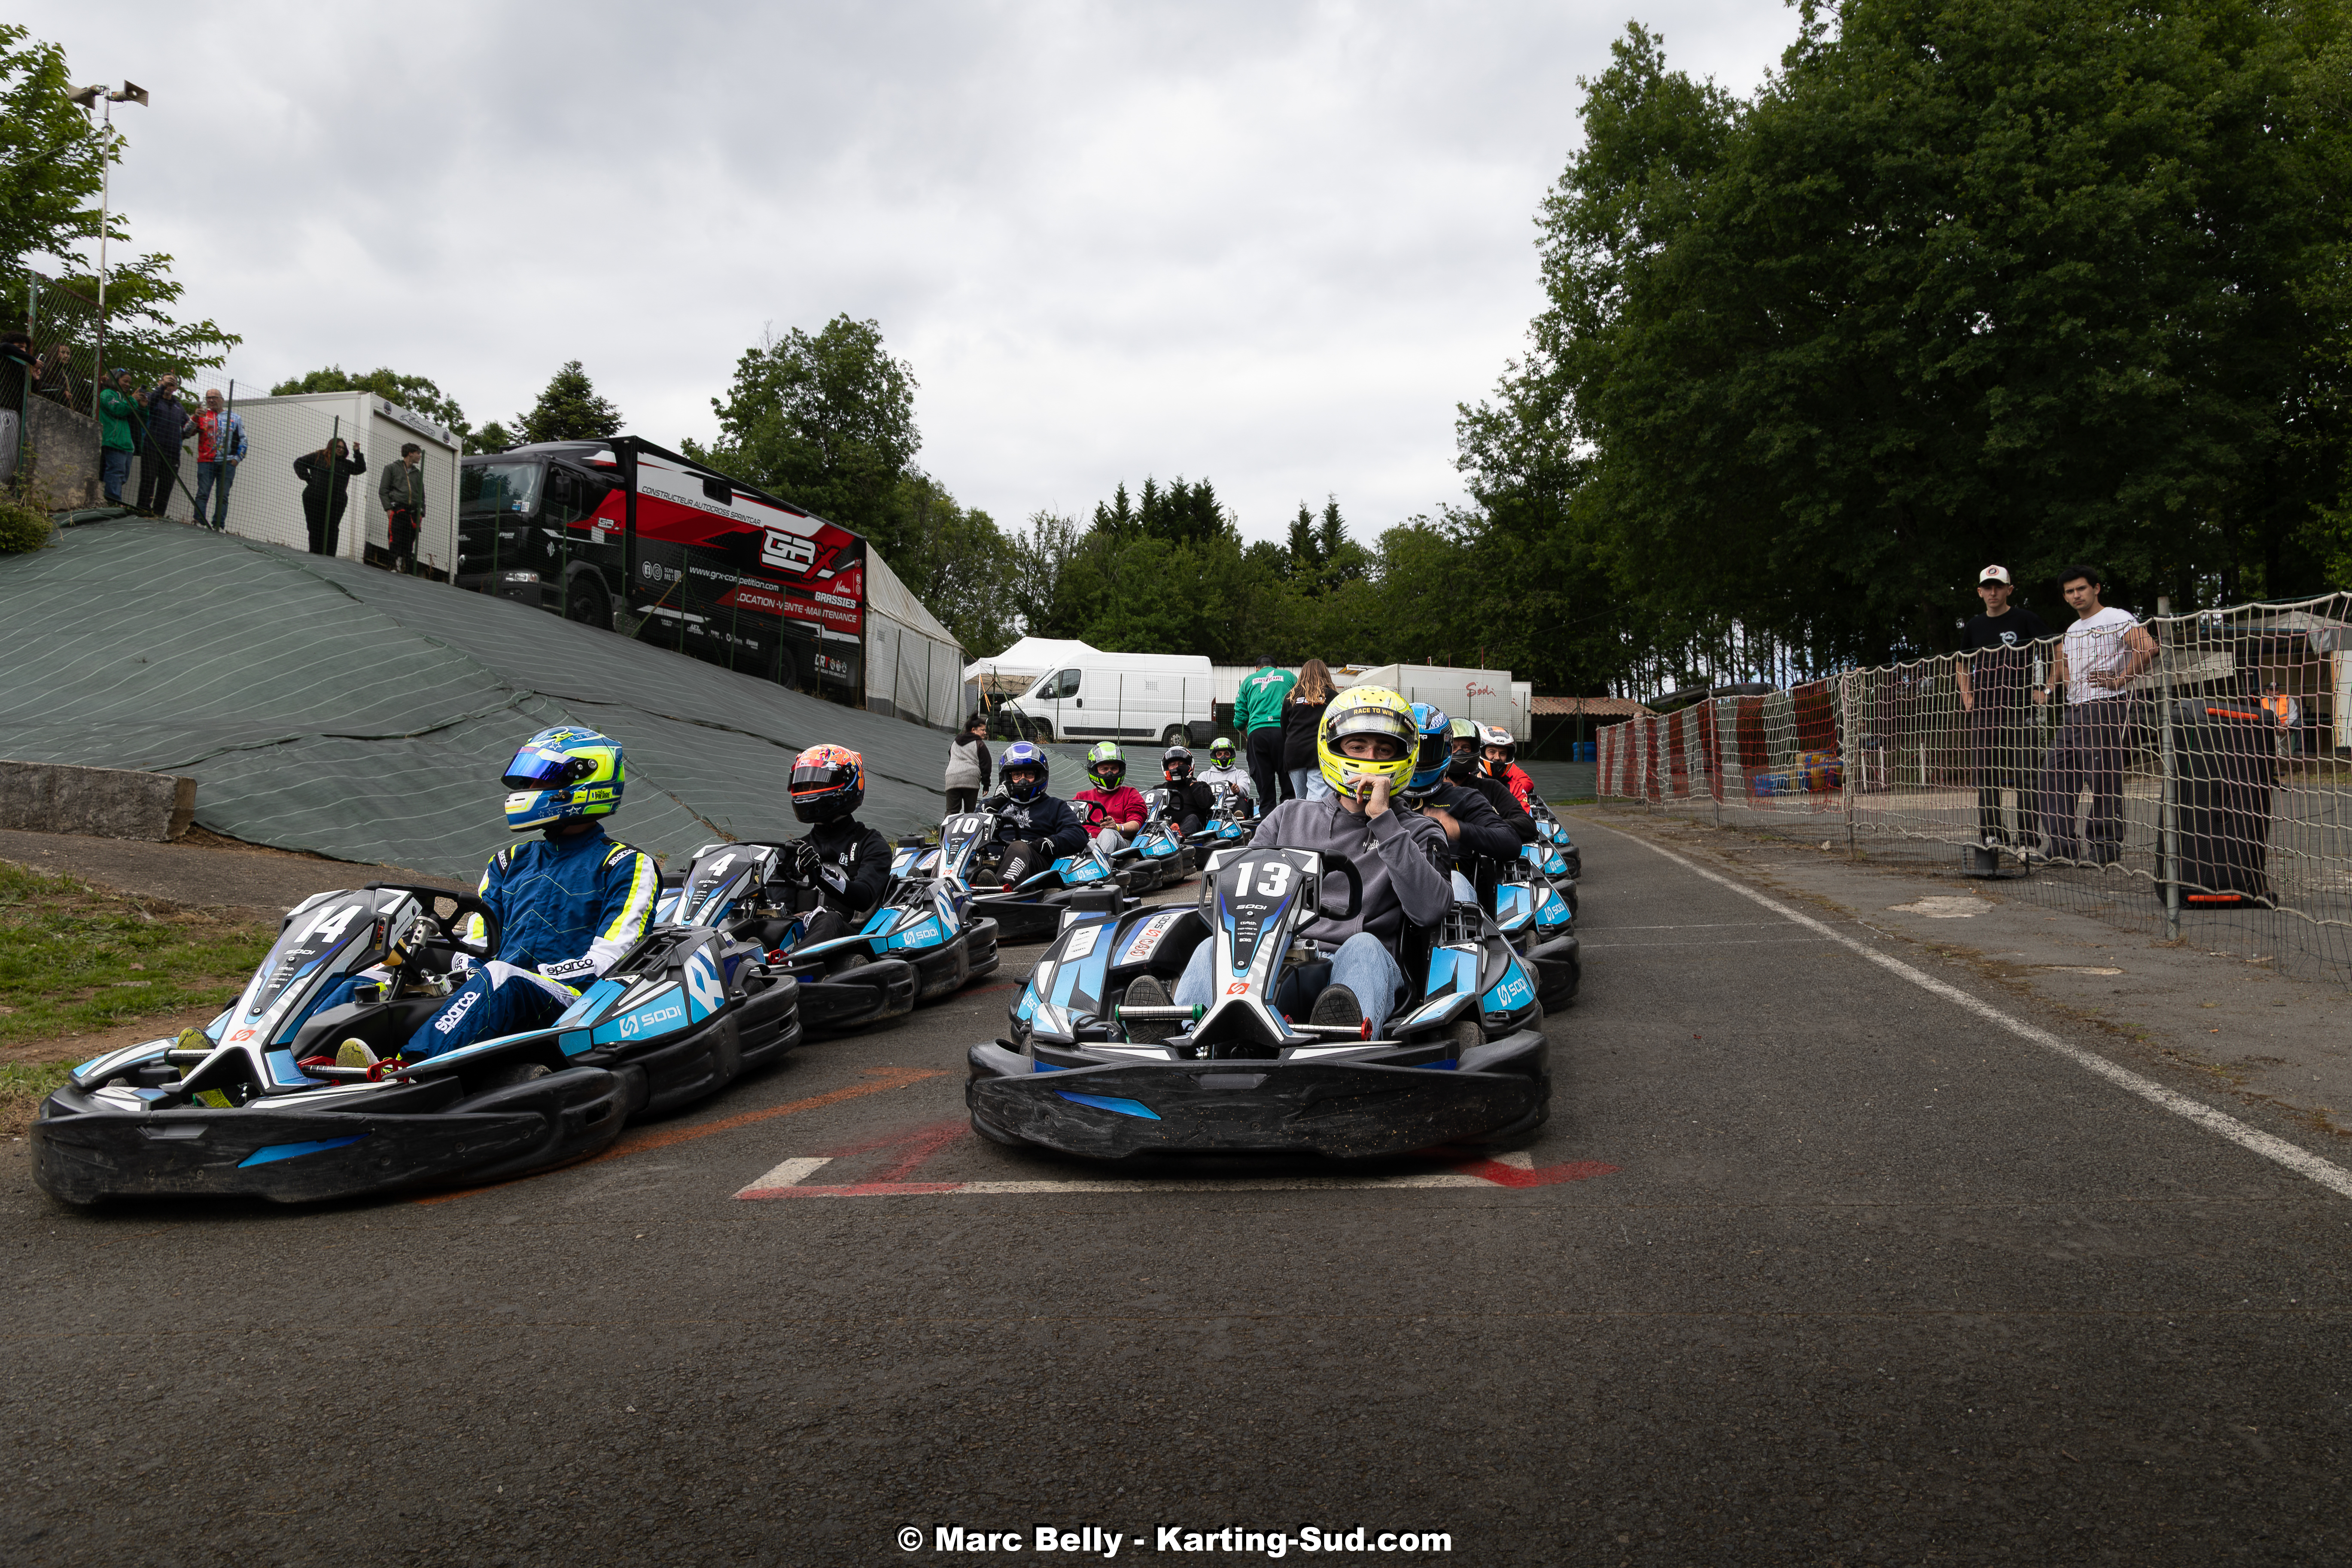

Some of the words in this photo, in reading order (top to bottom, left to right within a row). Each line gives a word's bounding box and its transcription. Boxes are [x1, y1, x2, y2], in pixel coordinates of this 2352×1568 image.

[642, 486, 693, 506] CONSTRUCTEUR
[694, 501, 730, 516] AUTOCROSS
[730, 512, 761, 526] SPRINTCAR
[762, 529, 840, 579] GRX
[833, 580, 851, 594] Nathan
[735, 593, 775, 608] OCATION
[815, 591, 856, 609] GRASSIES
[829, 670, 847, 679] TECHNOLOGY
[1466, 681, 1497, 697] Sodi
[1329, 714, 1342, 728] MSP
[1382, 709, 1394, 717] WIN
[1211, 784, 1223, 793] 15
[1145, 793, 1155, 804] 8
[951, 817, 980, 834] 10
[608, 848, 636, 866] sparco
[707, 853, 737, 877] 4
[1002, 856, 1026, 881] PUMA
[1084, 868, 1099, 876] SODI
[1235, 862, 1292, 897] 13
[294, 905, 364, 943] 14
[1154, 914, 1172, 929] SODI
[916, 928, 939, 940] SODI
[547, 958, 594, 976] sparco
[1508, 977, 1527, 997] SODI
[435, 991, 481, 1035] sparco
[641, 1005, 682, 1027] SODI
